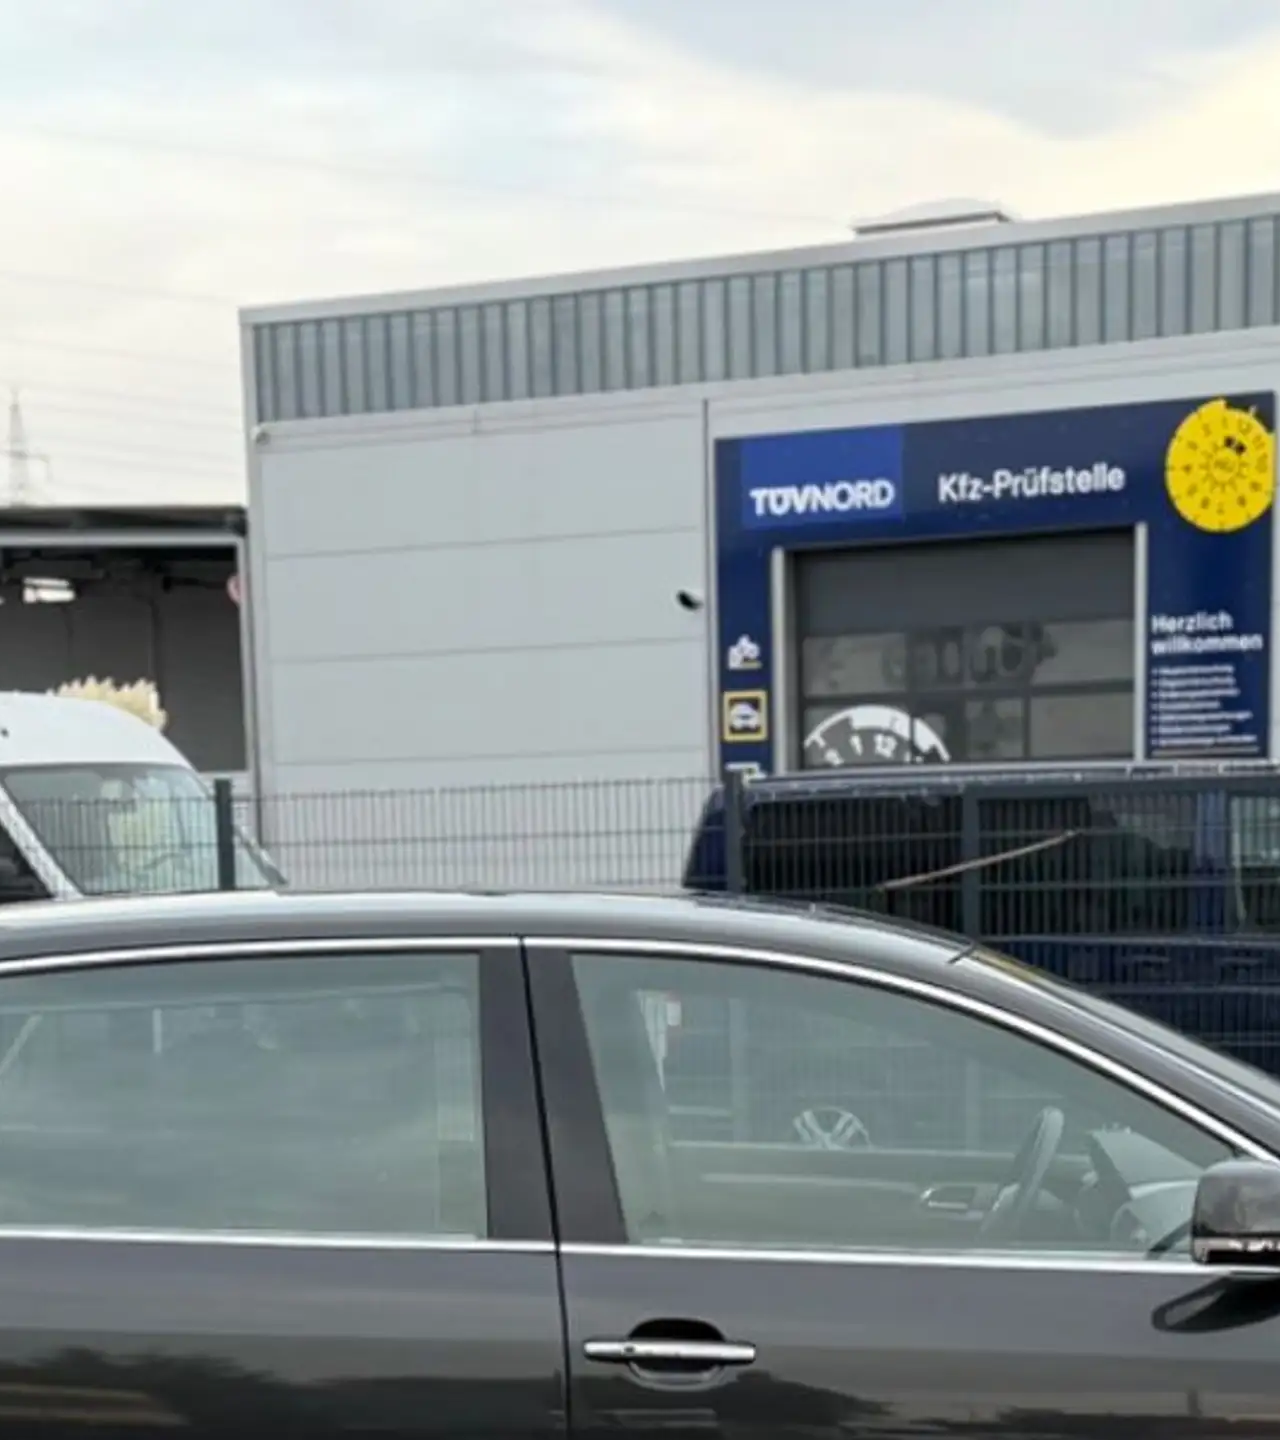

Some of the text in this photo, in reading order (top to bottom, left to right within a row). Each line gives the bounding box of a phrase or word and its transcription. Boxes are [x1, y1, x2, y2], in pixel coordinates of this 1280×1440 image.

[938, 462, 1126, 504] Kfz-Prüfstelle
[1151, 609, 1233, 634] Herzlich
[1151, 634, 1264, 655] willkommen
